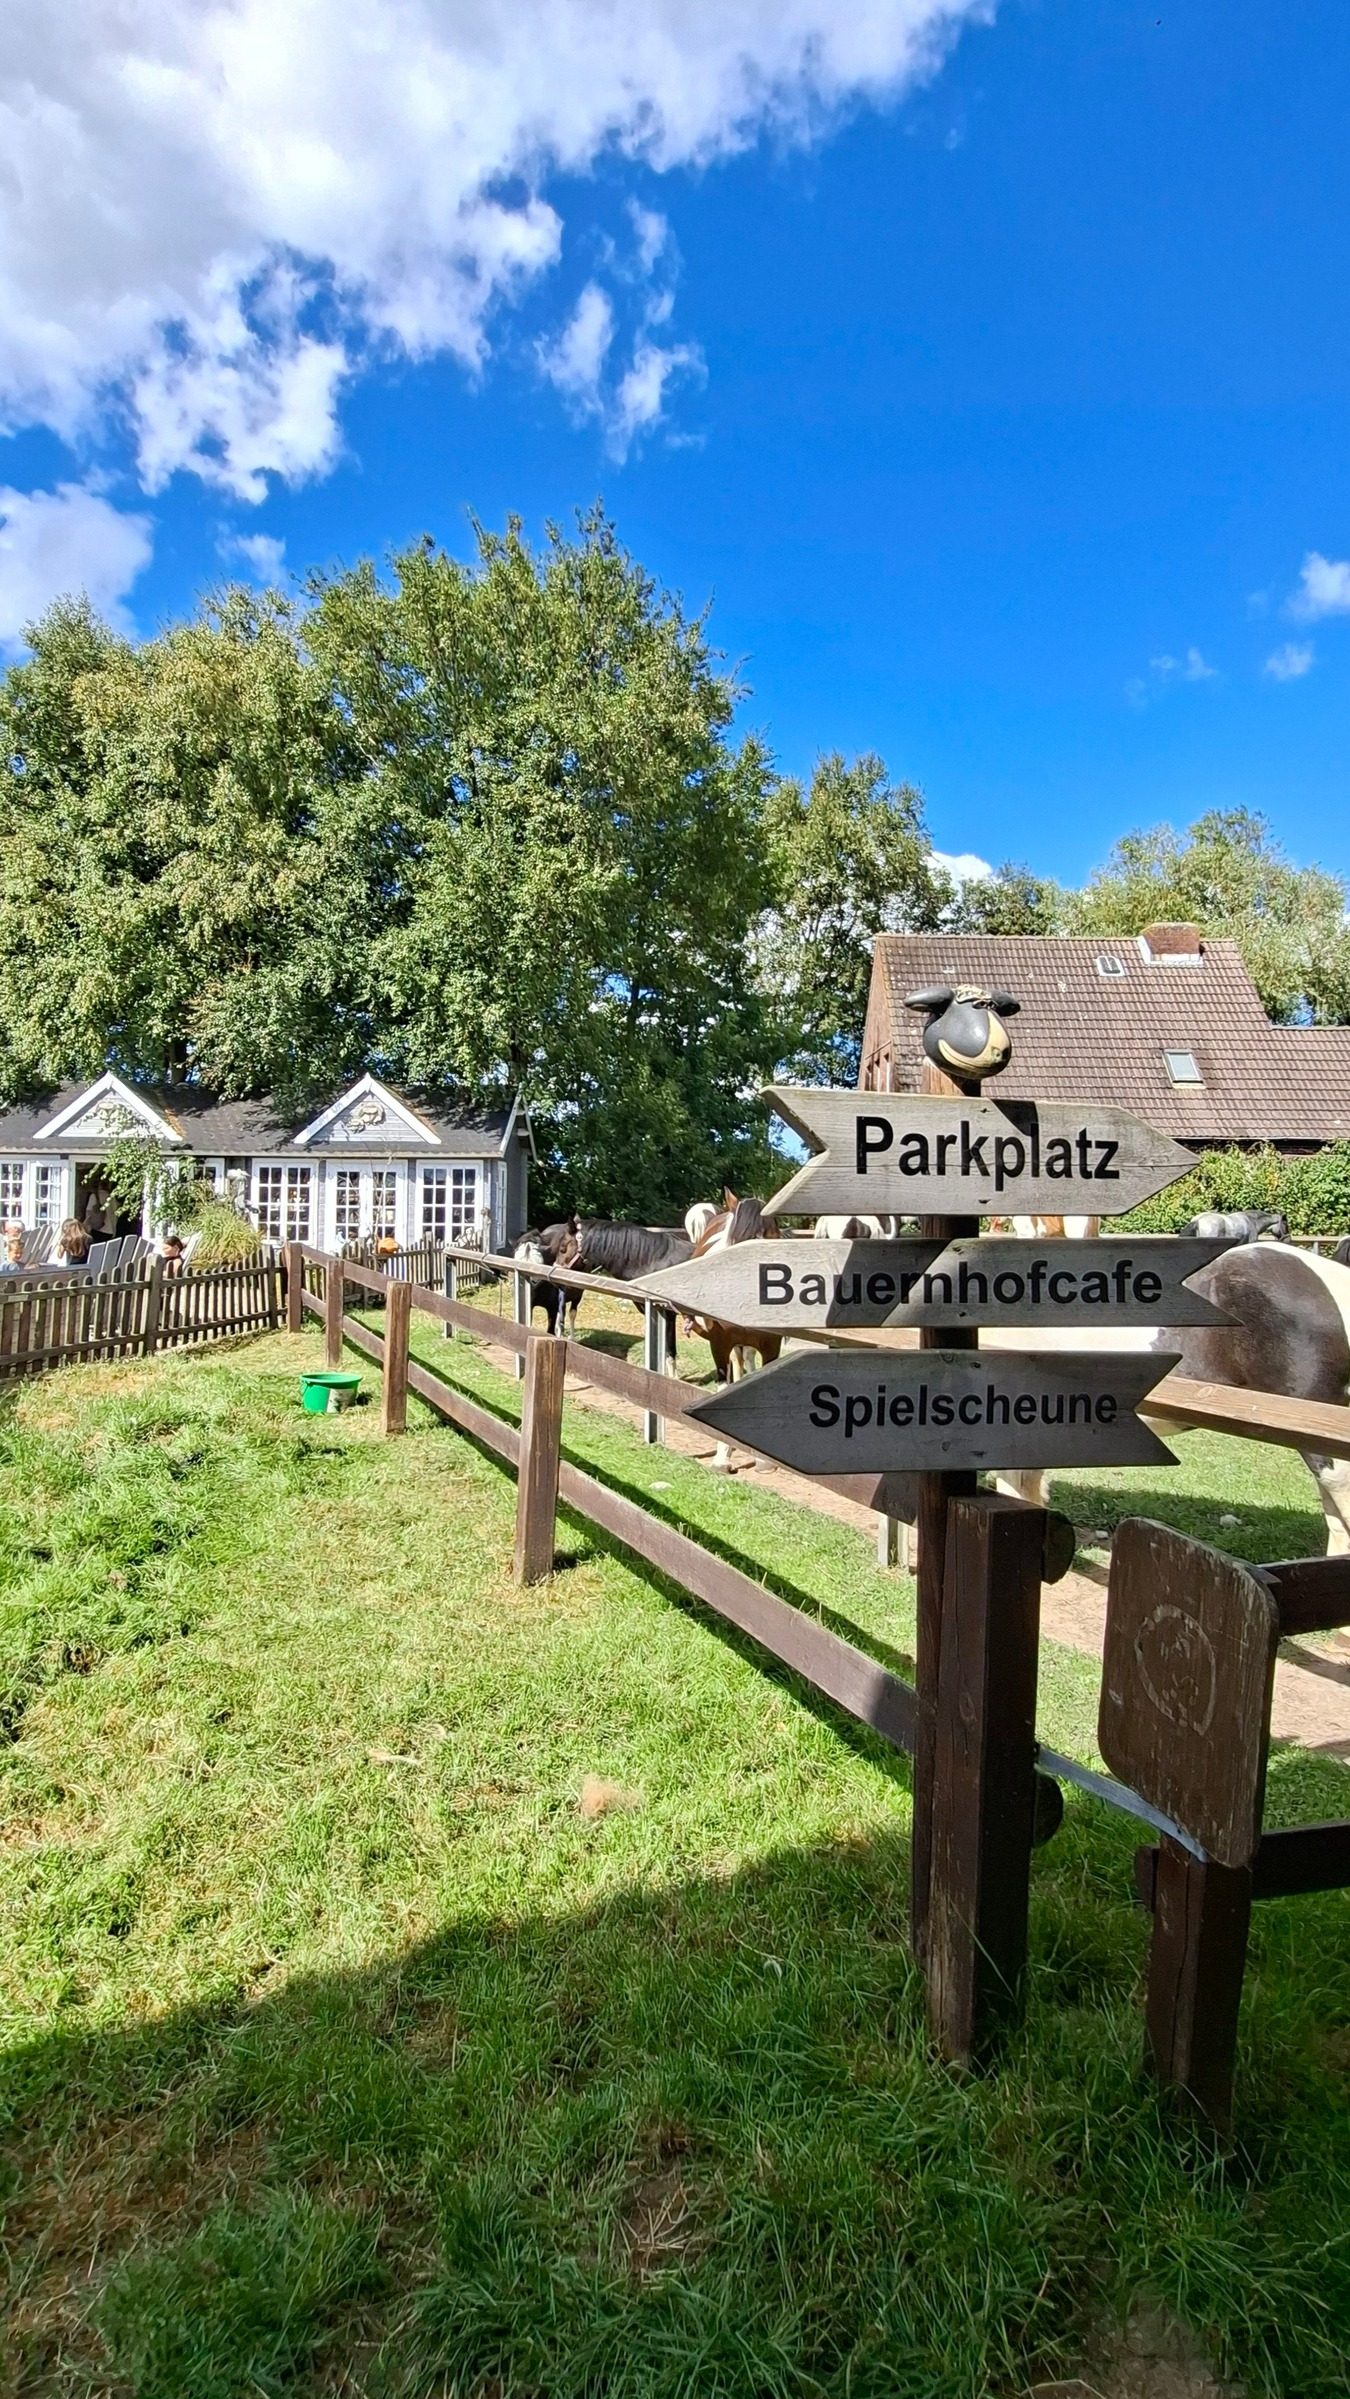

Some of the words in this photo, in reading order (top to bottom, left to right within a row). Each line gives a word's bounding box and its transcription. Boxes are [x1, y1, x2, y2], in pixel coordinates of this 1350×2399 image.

[856, 1116, 1120, 1191] Parkplatz
[758, 1260, 1163, 1306] Bauernhofcafe
[809, 1384, 1118, 1438] Spielscheune
